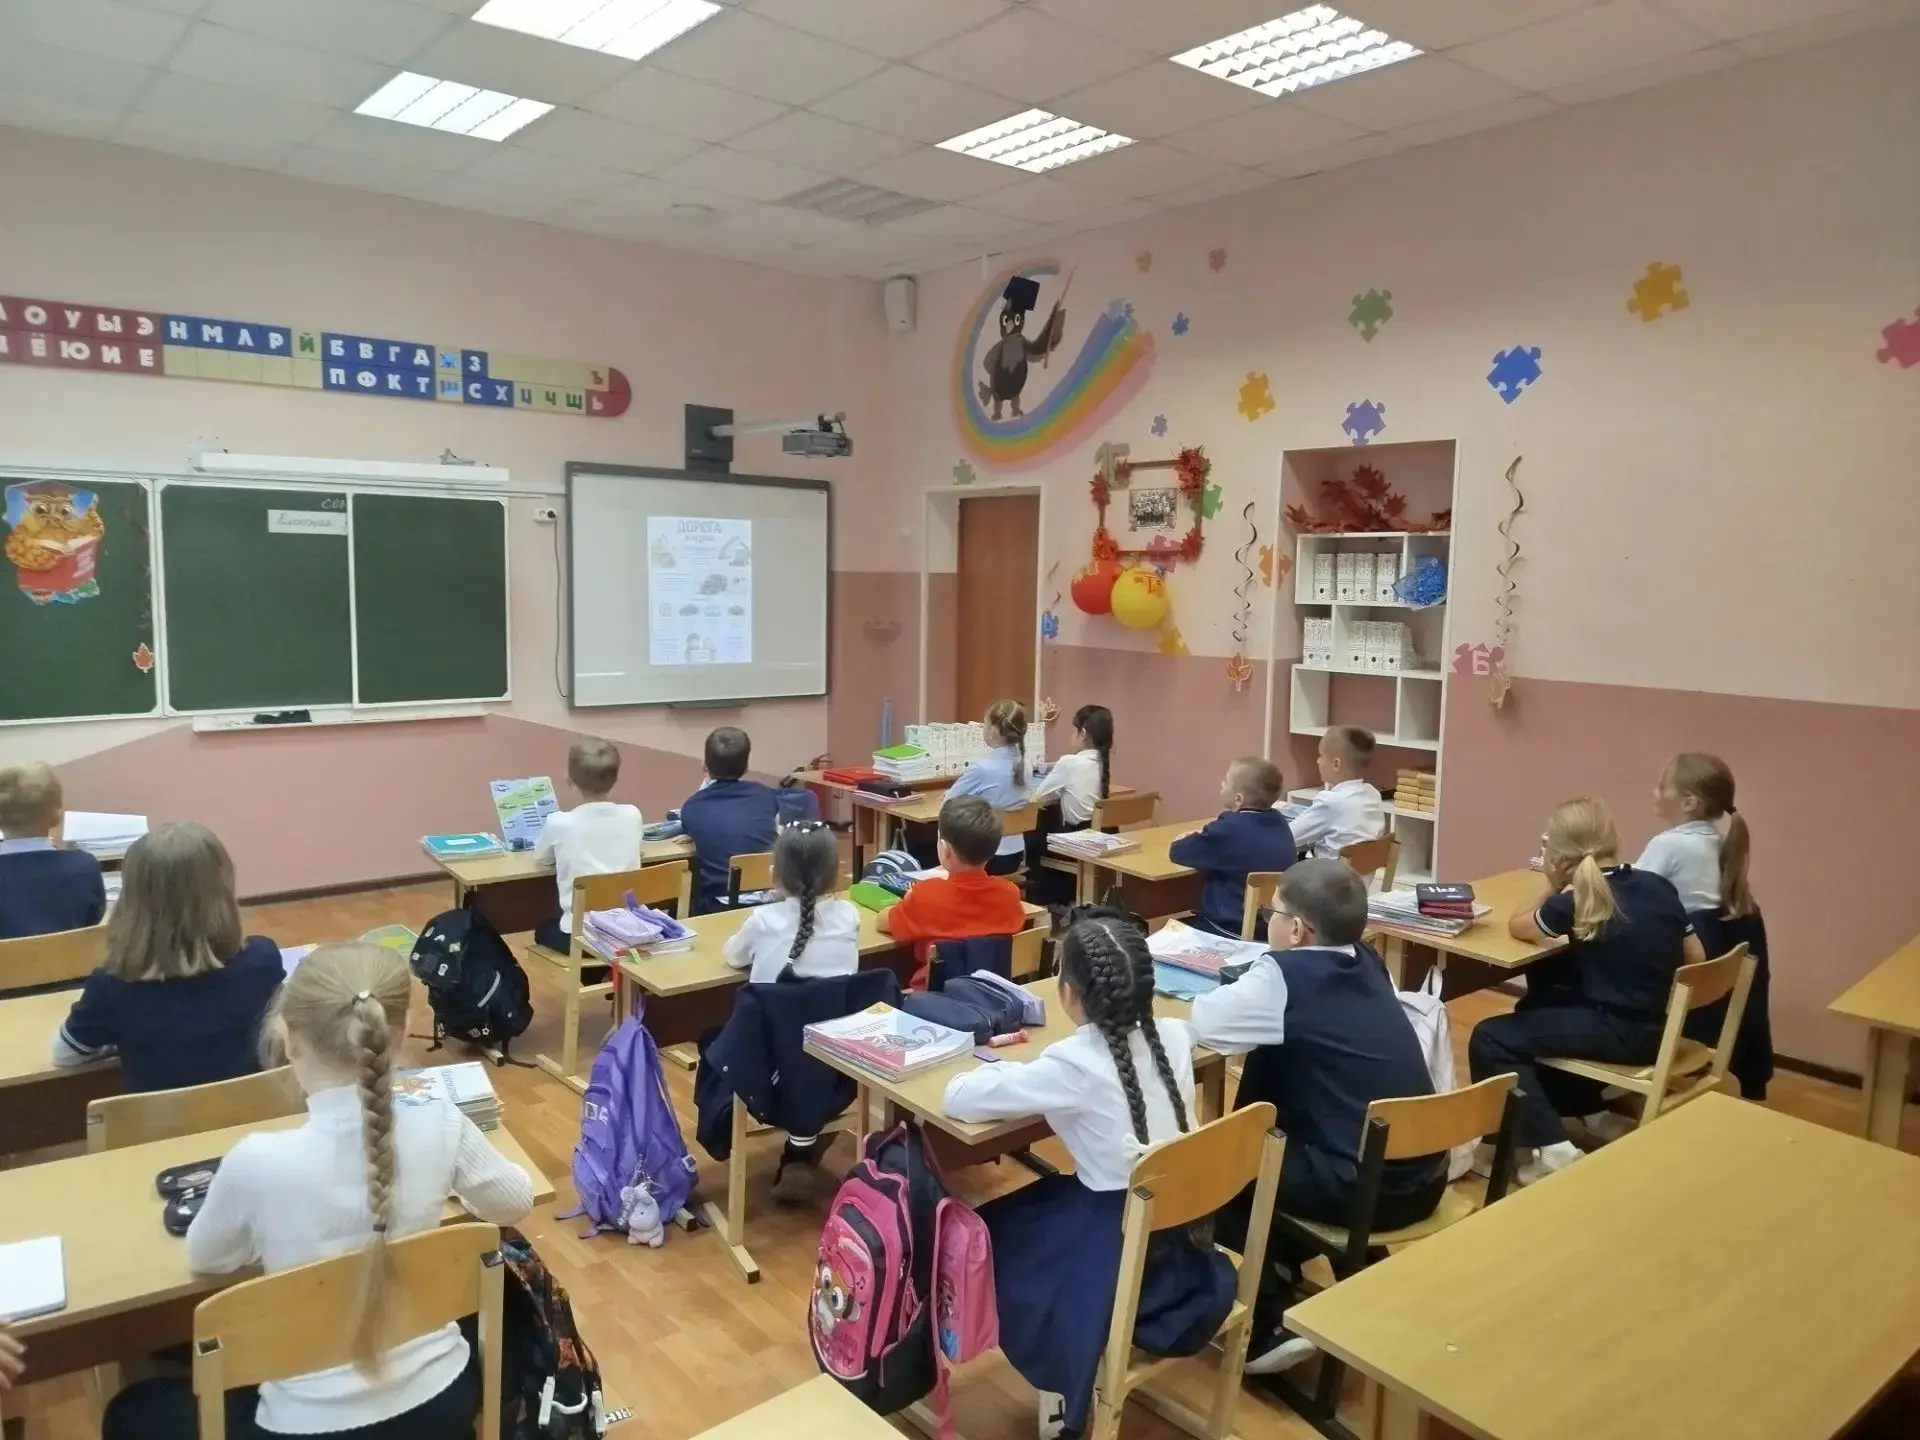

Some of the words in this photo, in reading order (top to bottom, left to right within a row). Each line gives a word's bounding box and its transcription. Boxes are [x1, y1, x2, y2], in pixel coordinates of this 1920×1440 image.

[24, 306, 47, 326] О
[64, 310, 82, 328] У
[97, 313, 122, 333] Ы
[136, 316, 154, 336] Э
[170, 321, 188, 340] Н
[202, 324, 223, 344] М
[238, 329, 254, 346] Л
[269, 332, 284, 350] Р
[300, 332, 314, 352] Й
[330, 340, 345, 356] Б
[360, 342, 373, 360] В
[388, 346, 400, 362] Г
[414, 349, 430, 367] Д
[469, 356, 481, 372] З
[30, 332, 47, 358] Ё
[60, 340, 91, 360] Ю
[102, 346, 121, 365] И
[139, 348, 154, 367] Е
[329, 368, 345, 384] П
[356, 370, 377, 387] Ф
[388, 374, 402, 390] К
[416, 376, 430, 393] Т
[469, 382, 482, 399] С
[496, 385, 508, 400] Х
[545, 390, 556, 406] Ч
[566, 393, 582, 410] Щ
[592, 396, 603, 410] Ь
